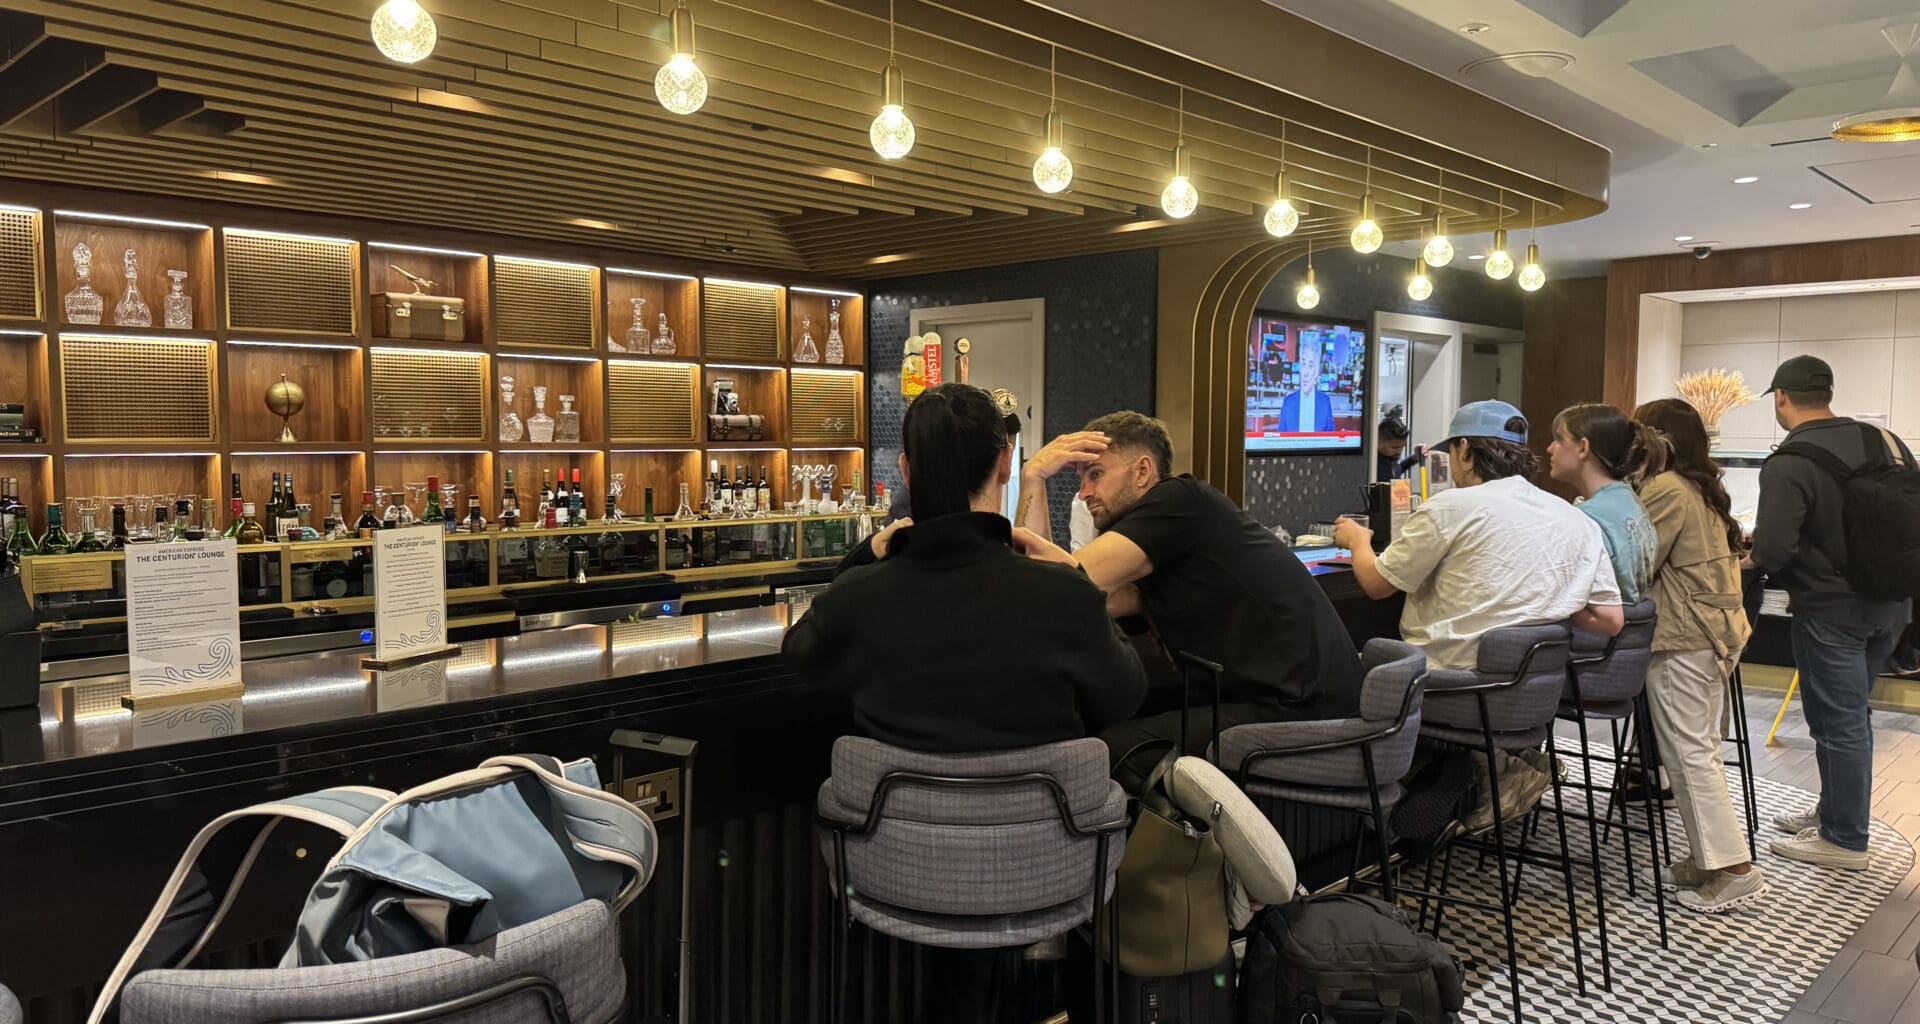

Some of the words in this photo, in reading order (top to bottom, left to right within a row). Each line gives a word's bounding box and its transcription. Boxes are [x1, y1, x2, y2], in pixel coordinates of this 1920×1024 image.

[927, 345, 938, 385] AMSTEL
[136, 555, 151, 563] THE
[197, 551, 225, 559] LOUNGE
